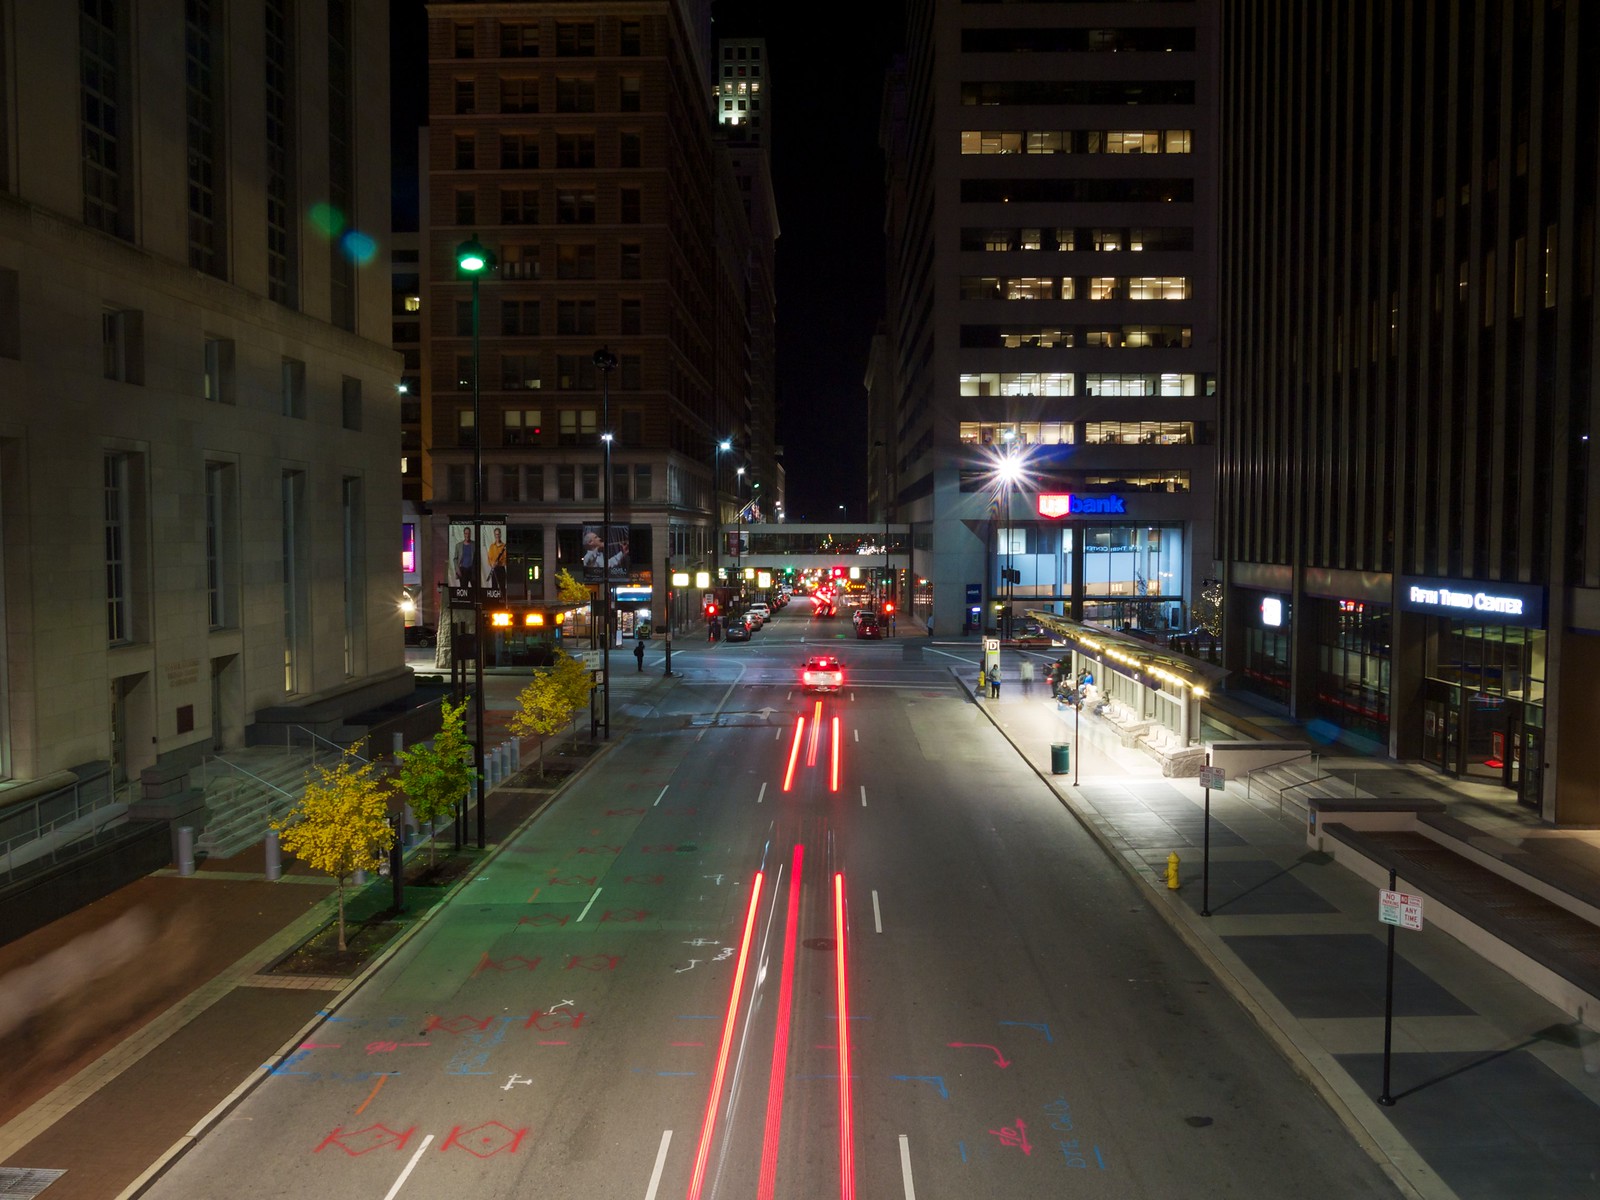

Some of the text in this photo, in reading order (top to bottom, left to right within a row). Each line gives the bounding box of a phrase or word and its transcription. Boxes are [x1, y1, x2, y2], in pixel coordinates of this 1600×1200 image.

[456, 589, 468, 597] RON
[1474, 593, 1523, 614] CENTER
[989, 642, 997, 650] D
[1404, 914, 1418, 922] TIME
